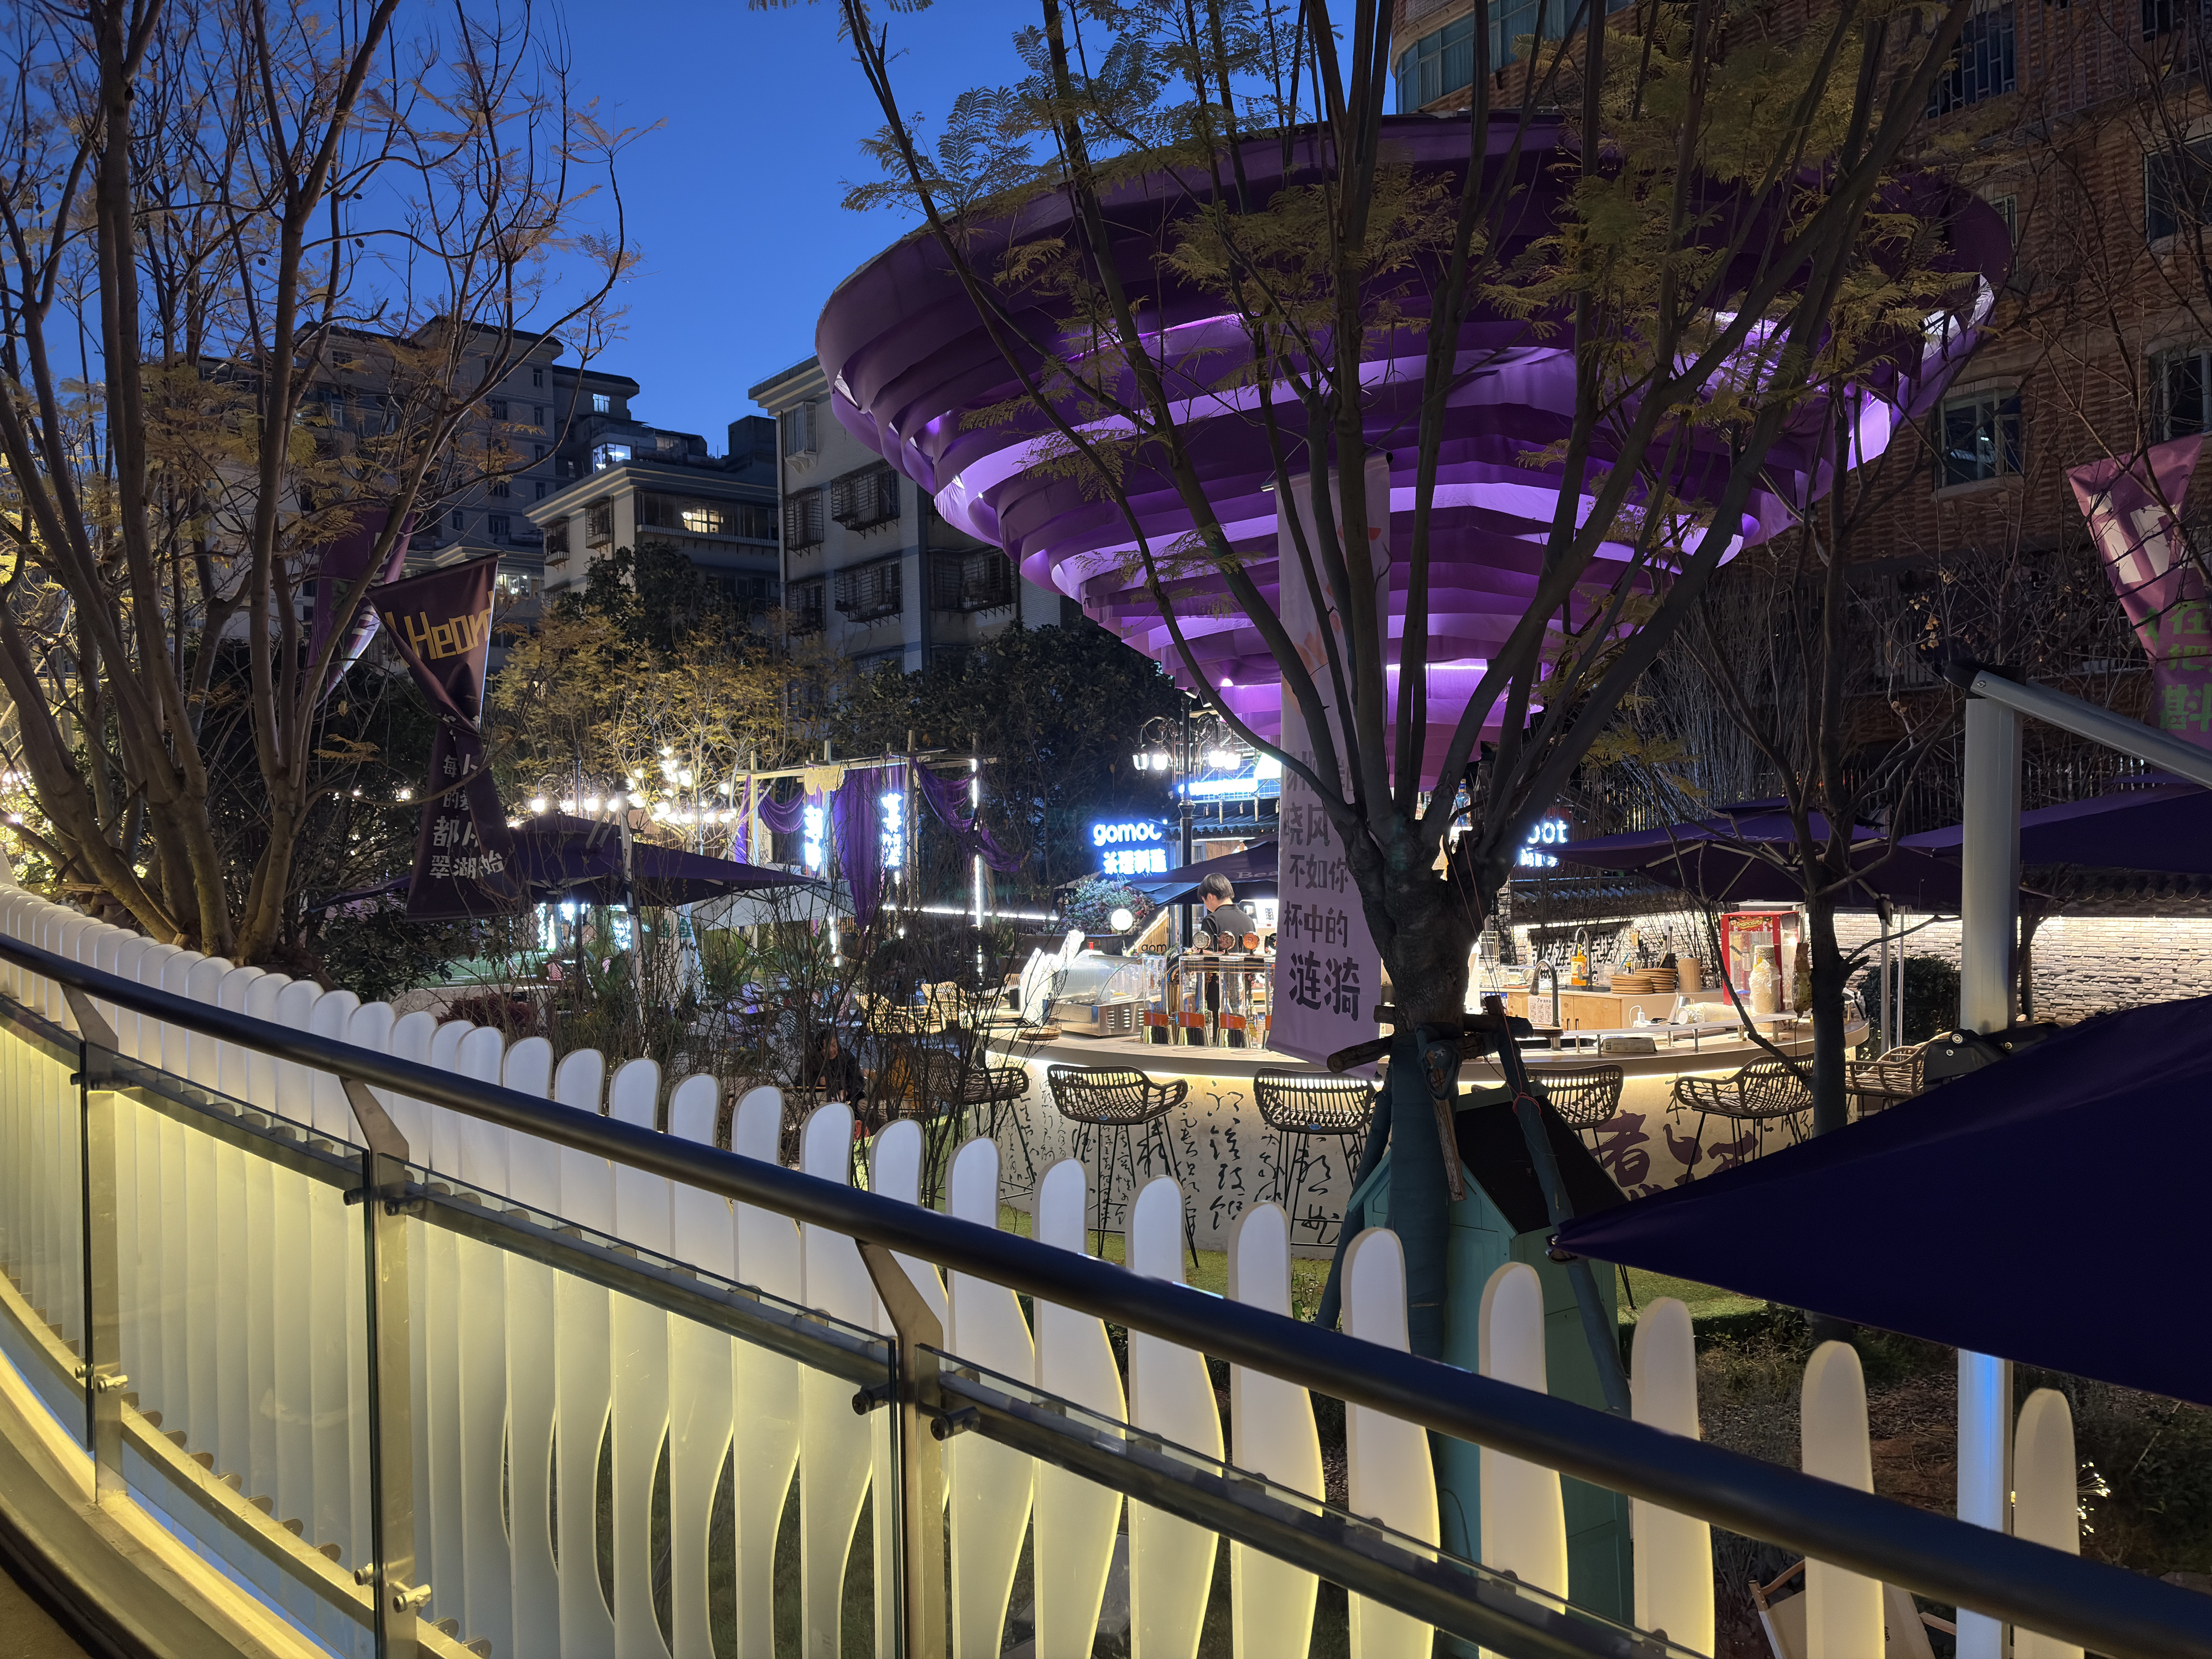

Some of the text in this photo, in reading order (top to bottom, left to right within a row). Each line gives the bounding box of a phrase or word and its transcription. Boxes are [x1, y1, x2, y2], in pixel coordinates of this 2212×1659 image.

[1289, 853, 1349, 894] 不如你
[1284, 901, 1348, 948] 杯中的
[1288, 950, 1360, 1021] 涟漪
